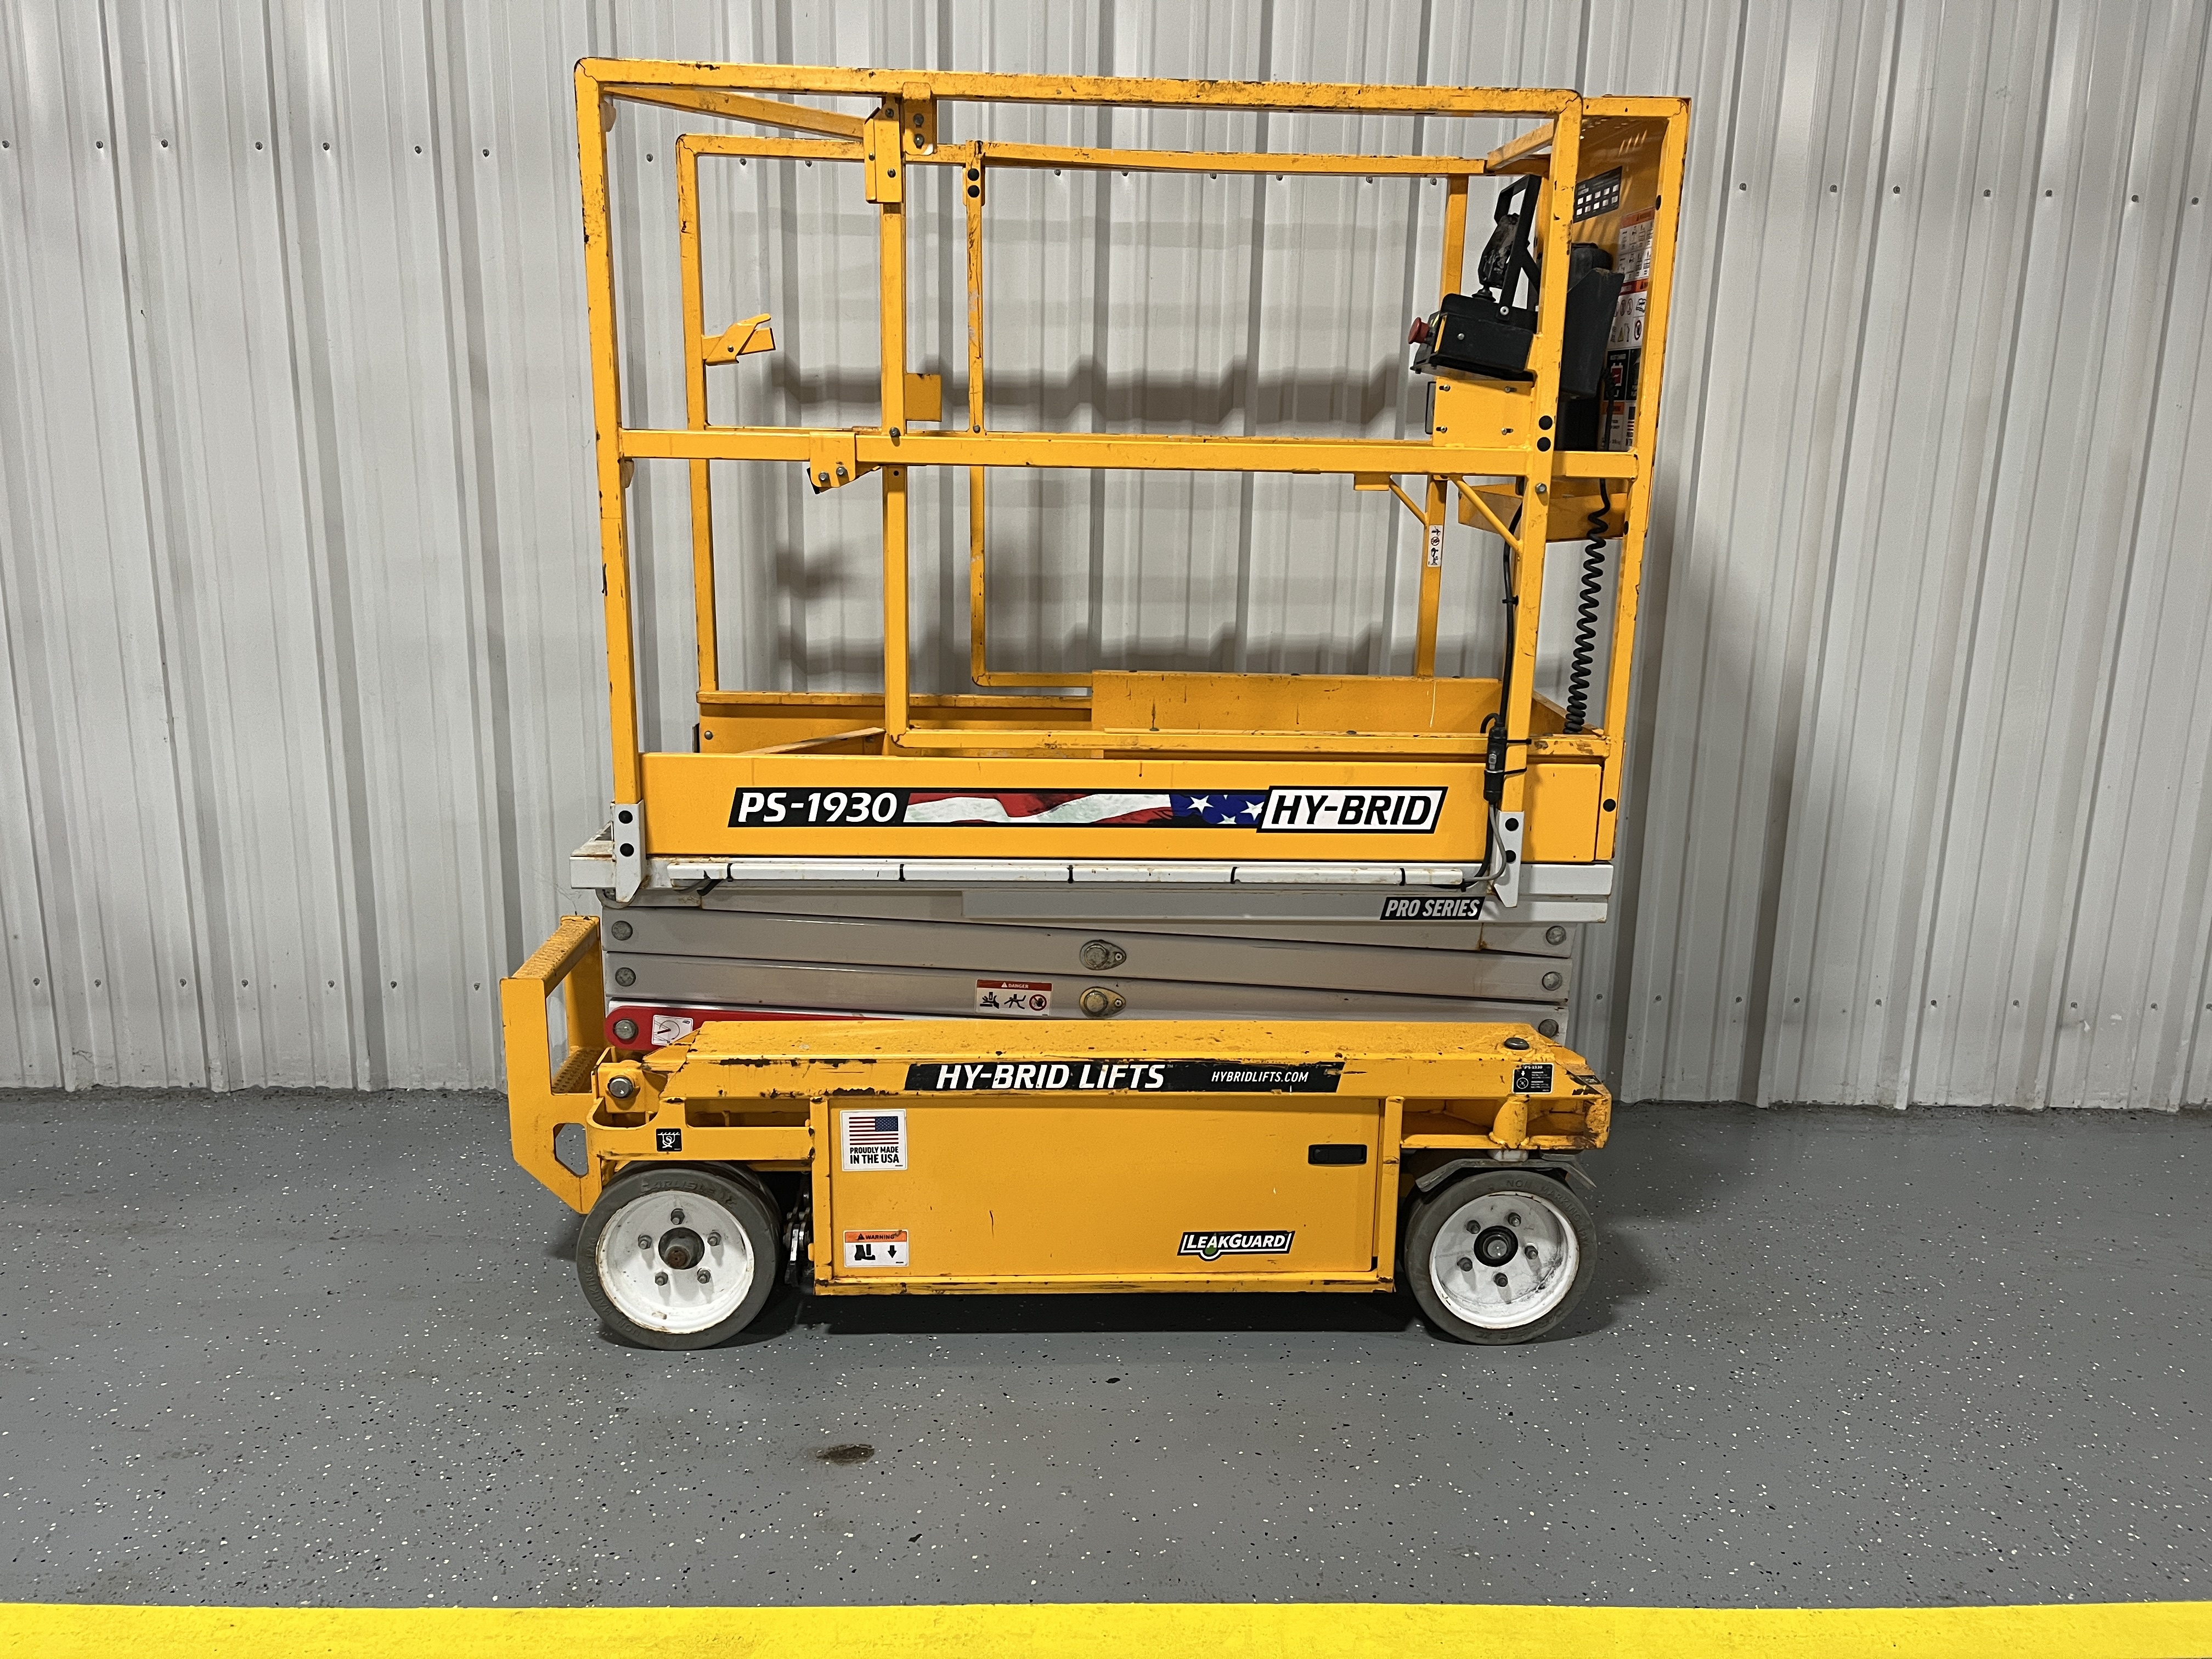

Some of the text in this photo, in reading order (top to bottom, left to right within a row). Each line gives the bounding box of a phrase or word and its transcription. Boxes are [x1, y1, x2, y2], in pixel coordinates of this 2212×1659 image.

[738, 792, 898, 823] PS-1930
[1271, 794, 1431, 825] HY-BRID
[1385, 899, 1480, 917] PRO SERIES
[935, 1064, 1069, 1089] HY-BRID
[1078, 1064, 1166, 1088] LIFTS
[1211, 1071, 1309, 1082] HYBRIDLIFTS.COM
[850, 1154, 900, 1164] IN THE USA
[1186, 1234, 1285, 1249] LEAKGUARD
